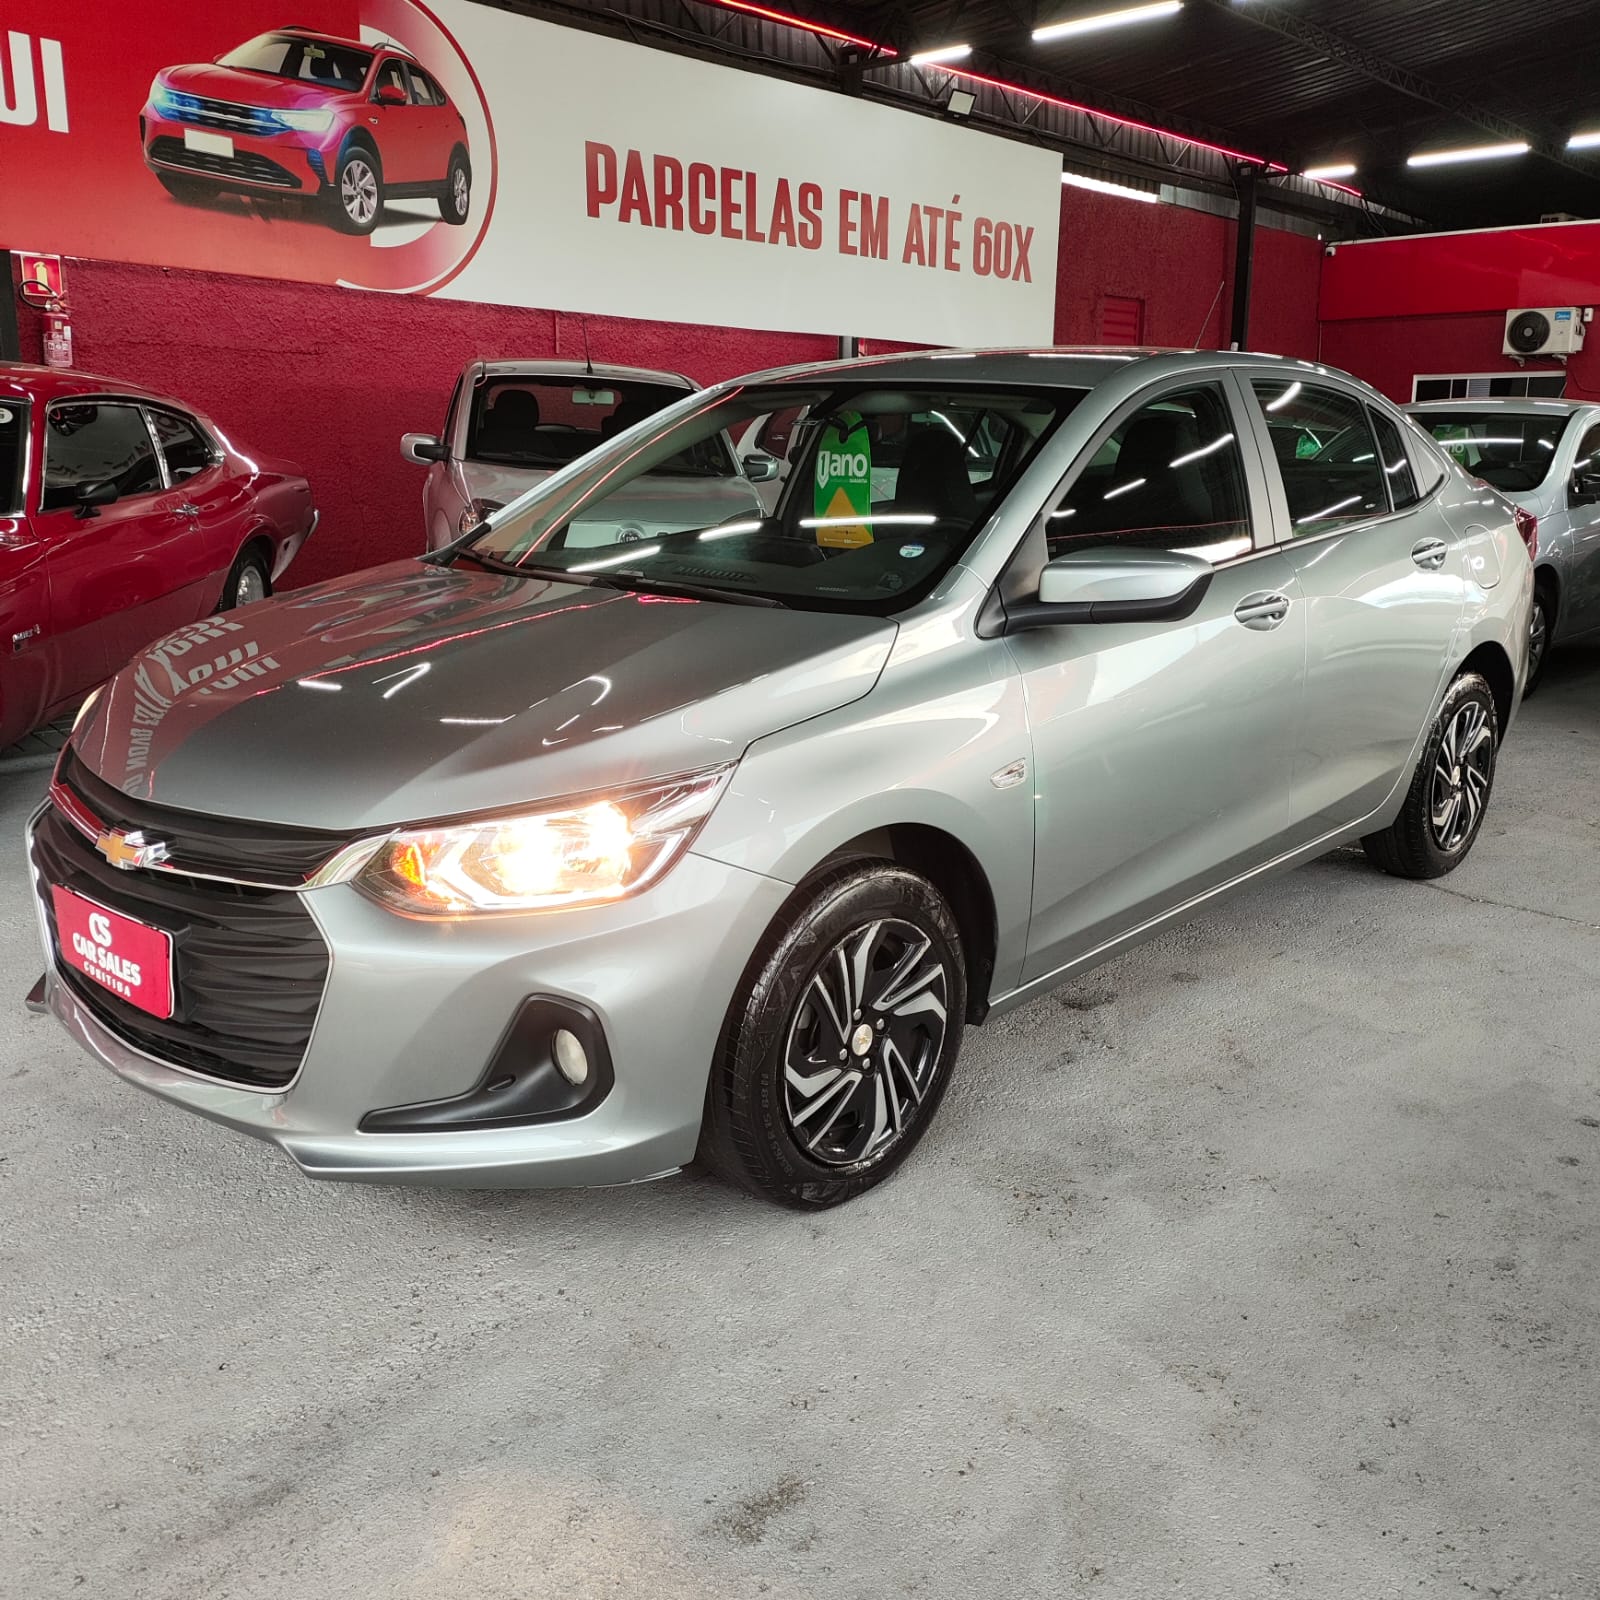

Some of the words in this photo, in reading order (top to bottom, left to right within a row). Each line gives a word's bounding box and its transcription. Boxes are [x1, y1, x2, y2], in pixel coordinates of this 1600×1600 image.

[585, 141, 822, 250] PARCELAS
[839, 188, 889, 260] EM
[902, 194, 962, 272] ATÉ
[972, 216, 1034, 283] 60X
[89, 912, 112, 947] CS
[72, 932, 97, 963] CAR
[97, 947, 142, 986] SALES
[84, 961, 131, 997] CURITIBA
